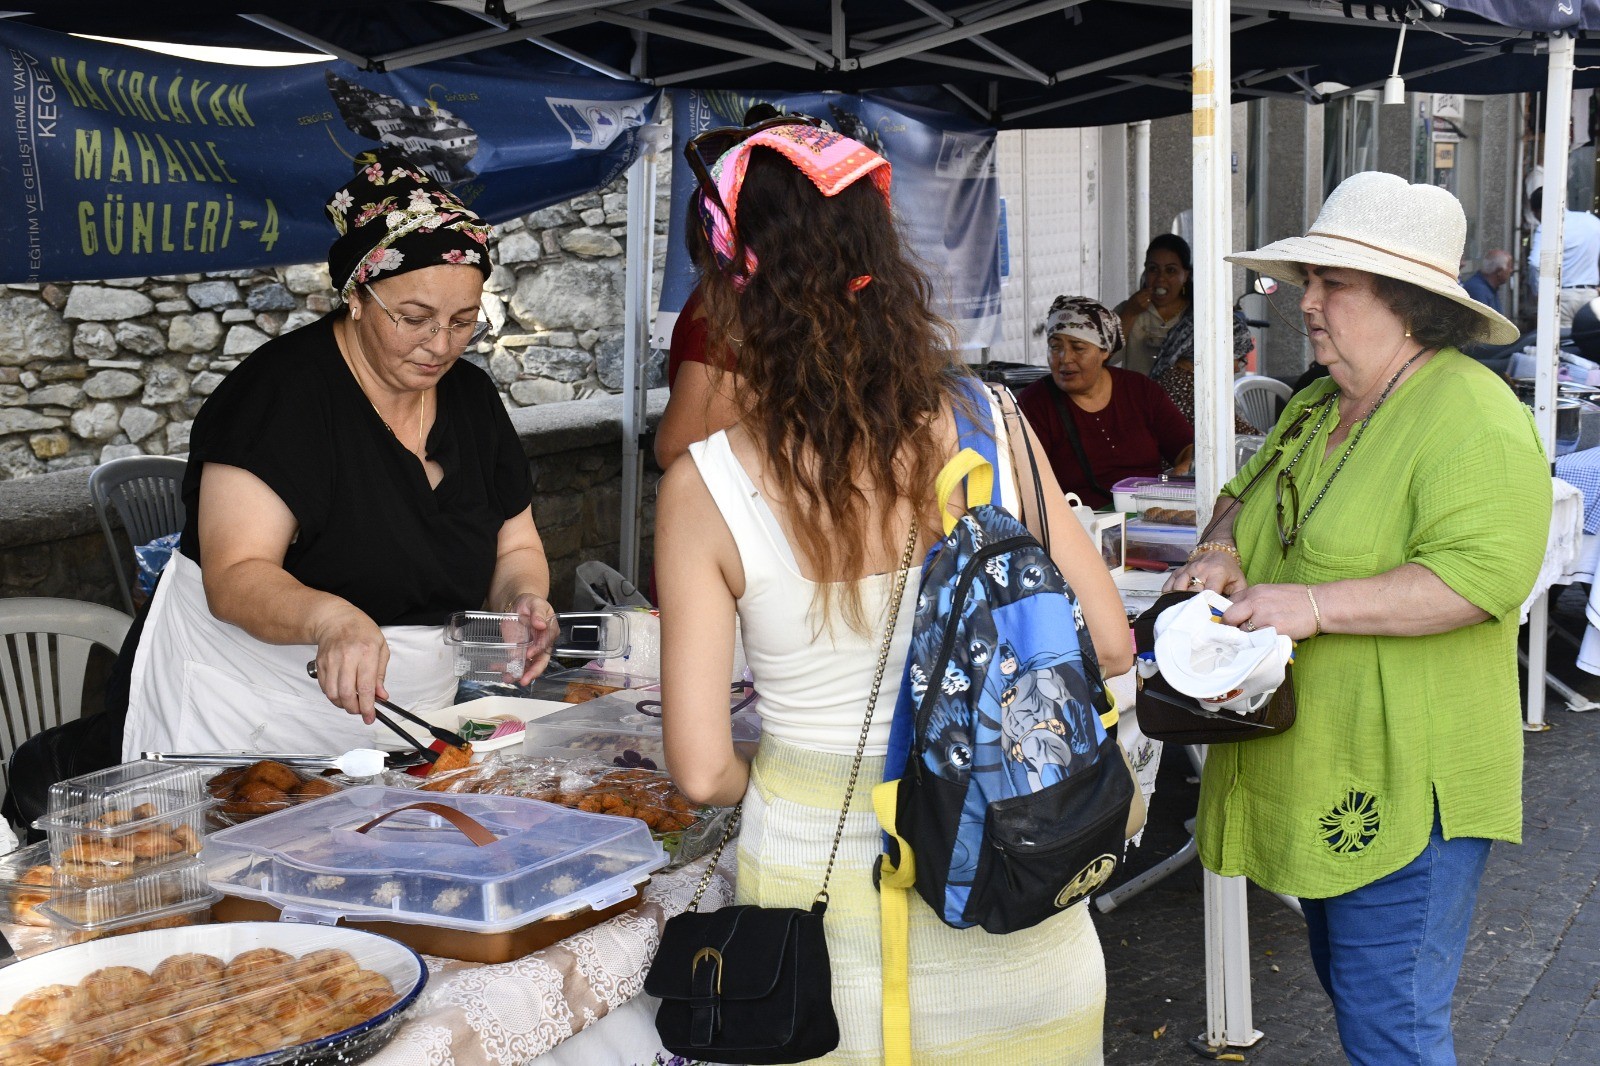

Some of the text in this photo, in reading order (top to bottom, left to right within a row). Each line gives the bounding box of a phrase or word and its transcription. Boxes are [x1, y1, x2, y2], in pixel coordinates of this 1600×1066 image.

[24, 52, 57, 138] KEGEV
[51, 57, 255, 127] HATIRLAYAN
[74, 127, 239, 184] MAHALLE
[25, 194, 38, 215] VE
